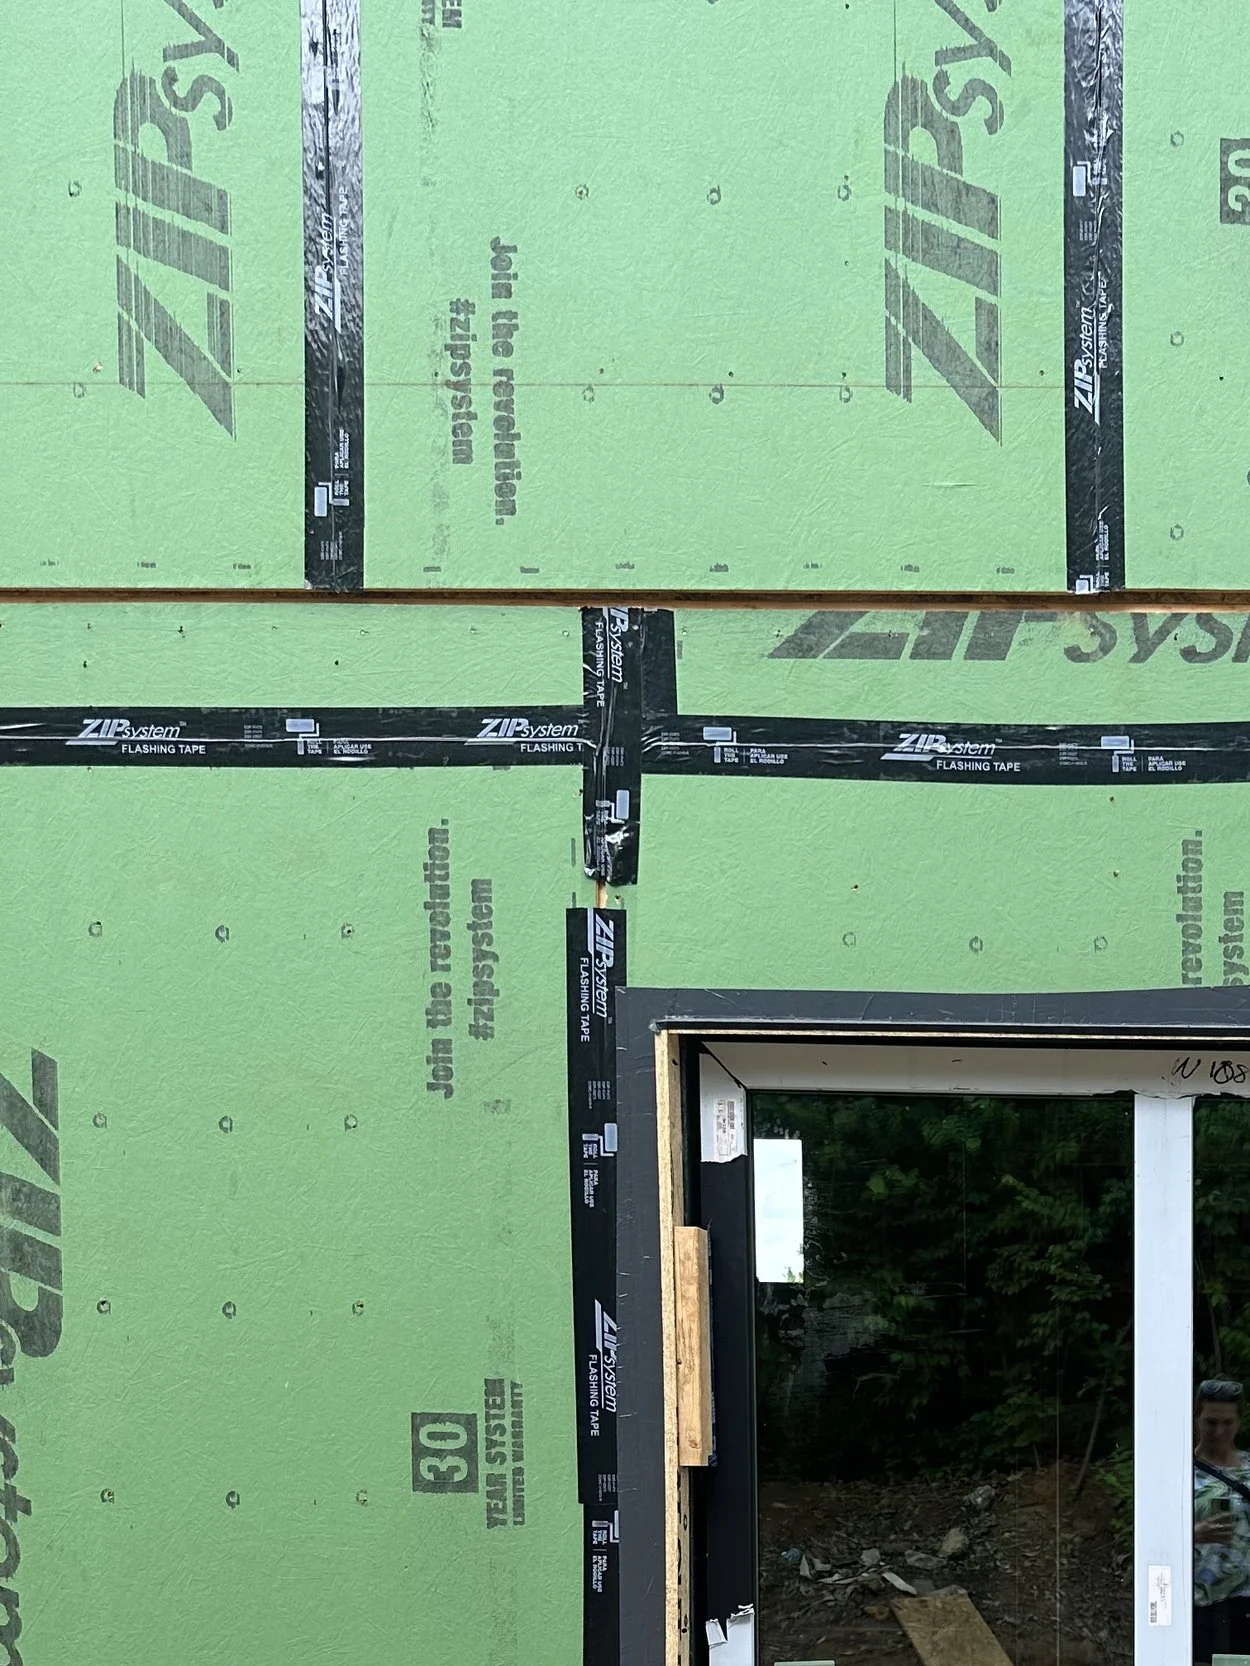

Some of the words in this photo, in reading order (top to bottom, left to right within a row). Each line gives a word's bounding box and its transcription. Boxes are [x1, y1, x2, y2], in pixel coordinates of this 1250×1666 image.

[490, 236, 518, 299] Join
[492, 310, 519, 358] the
[445, 298, 477, 465] #zipsystem
[493, 368, 522, 525] revolution.
[596, 622, 604, 679] FLASHING
[596, 681, 605, 707] TAPE
[72, 719, 180, 742] ZIPsystem
[121, 744, 176, 754] FLASHING
[179, 744, 206, 755] TAPE
[471, 718, 579, 742] ZIPsystem
[520, 743, 568, 752] FLASHING
[937, 760, 990, 771] FLASHING
[993, 762, 1021, 772] TAPE
[423, 819, 452, 973] revolution.
[467, 879, 500, 1041] #zipsystem
[580, 957, 589, 1012] FLASHING
[590, 910, 614, 1018] ZIPsystem
[425, 982, 452, 1029] the
[580, 1014, 590, 1042] TAPE
[426, 1038, 454, 1099] Join
[588, 1354, 598, 1413] FLASHING
[484, 1378, 507, 1466] SYSTEM
[590, 1415, 600, 1437] TAPE
[419, 1422, 468, 1482] 30
[486, 1473, 508, 1530] YEAR
